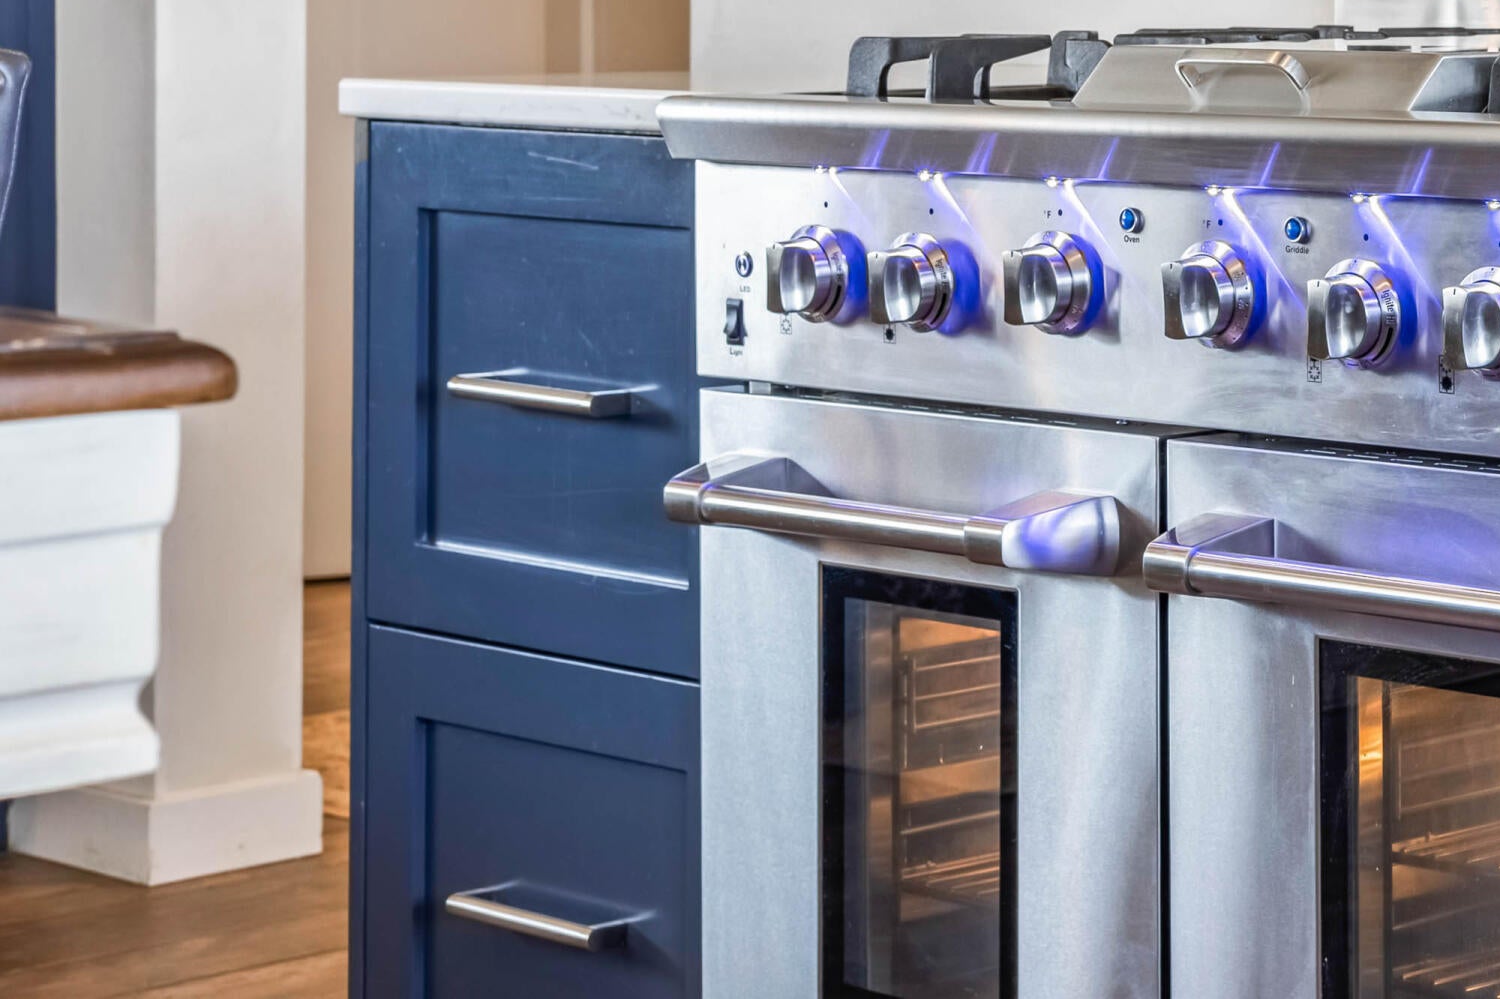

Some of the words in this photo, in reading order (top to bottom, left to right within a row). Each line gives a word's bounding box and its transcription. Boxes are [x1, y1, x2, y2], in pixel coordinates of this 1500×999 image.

[1123, 234, 1141, 245] Oven
[1285, 244, 1310, 256] Griddle
[1380, 288, 1396, 313] Ignite
